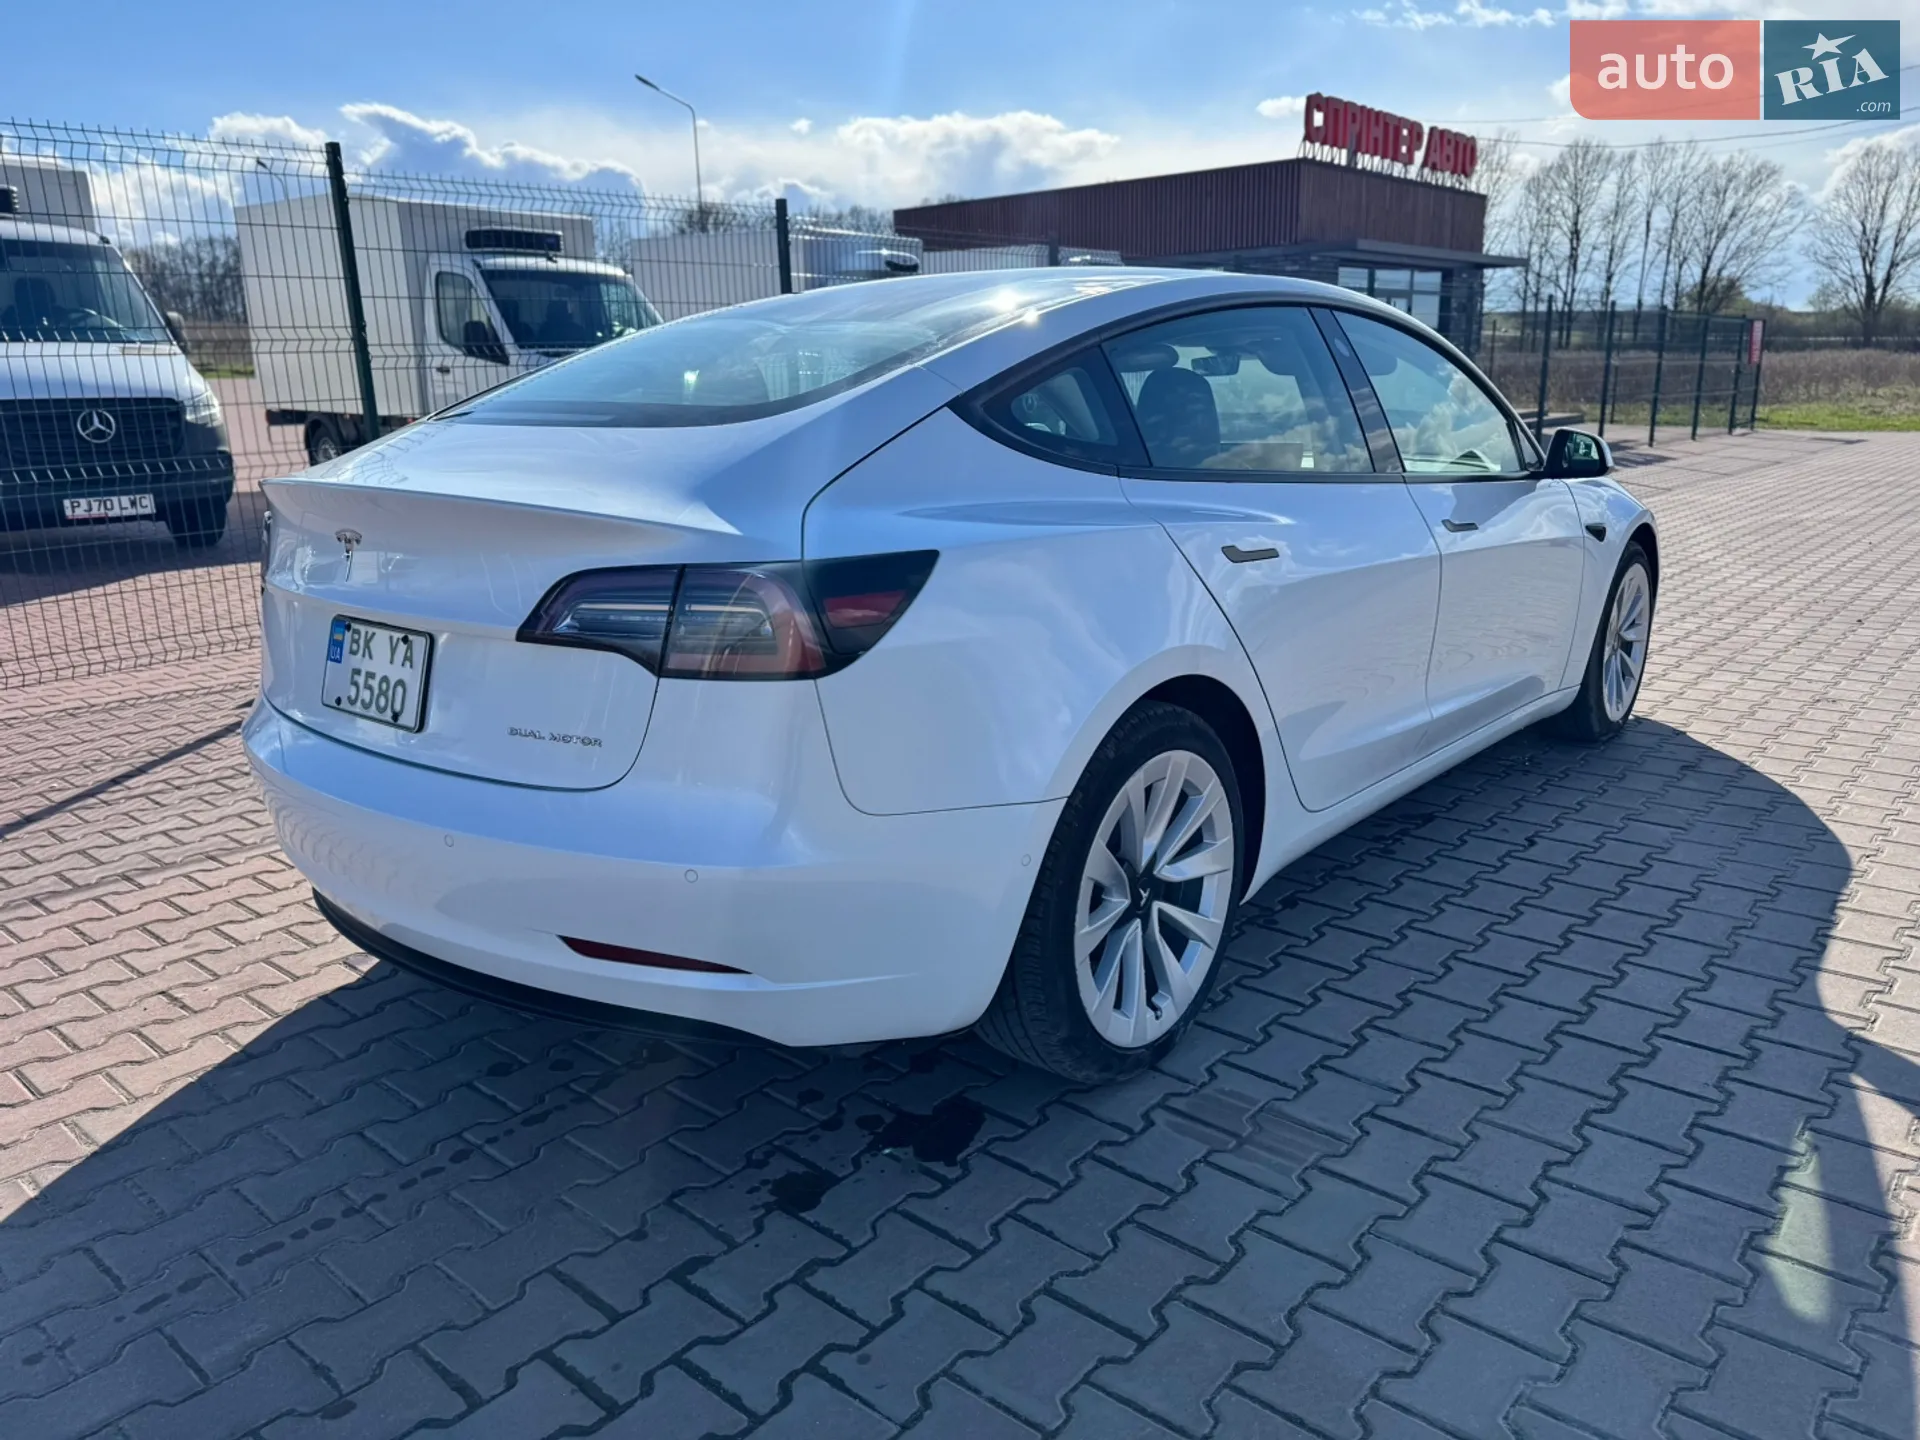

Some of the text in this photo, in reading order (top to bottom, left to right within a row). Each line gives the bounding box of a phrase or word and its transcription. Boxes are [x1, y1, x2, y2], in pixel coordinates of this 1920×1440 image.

[1305, 92, 1478, 178] СПРІНТЕР АВТО
[70, 498, 115, 513] PJ70
[330, 644, 341, 660] UA
[348, 627, 414, 669] BK YA
[346, 667, 407, 718] 5580
[507, 726, 603, 748] DUAL MOTOR
